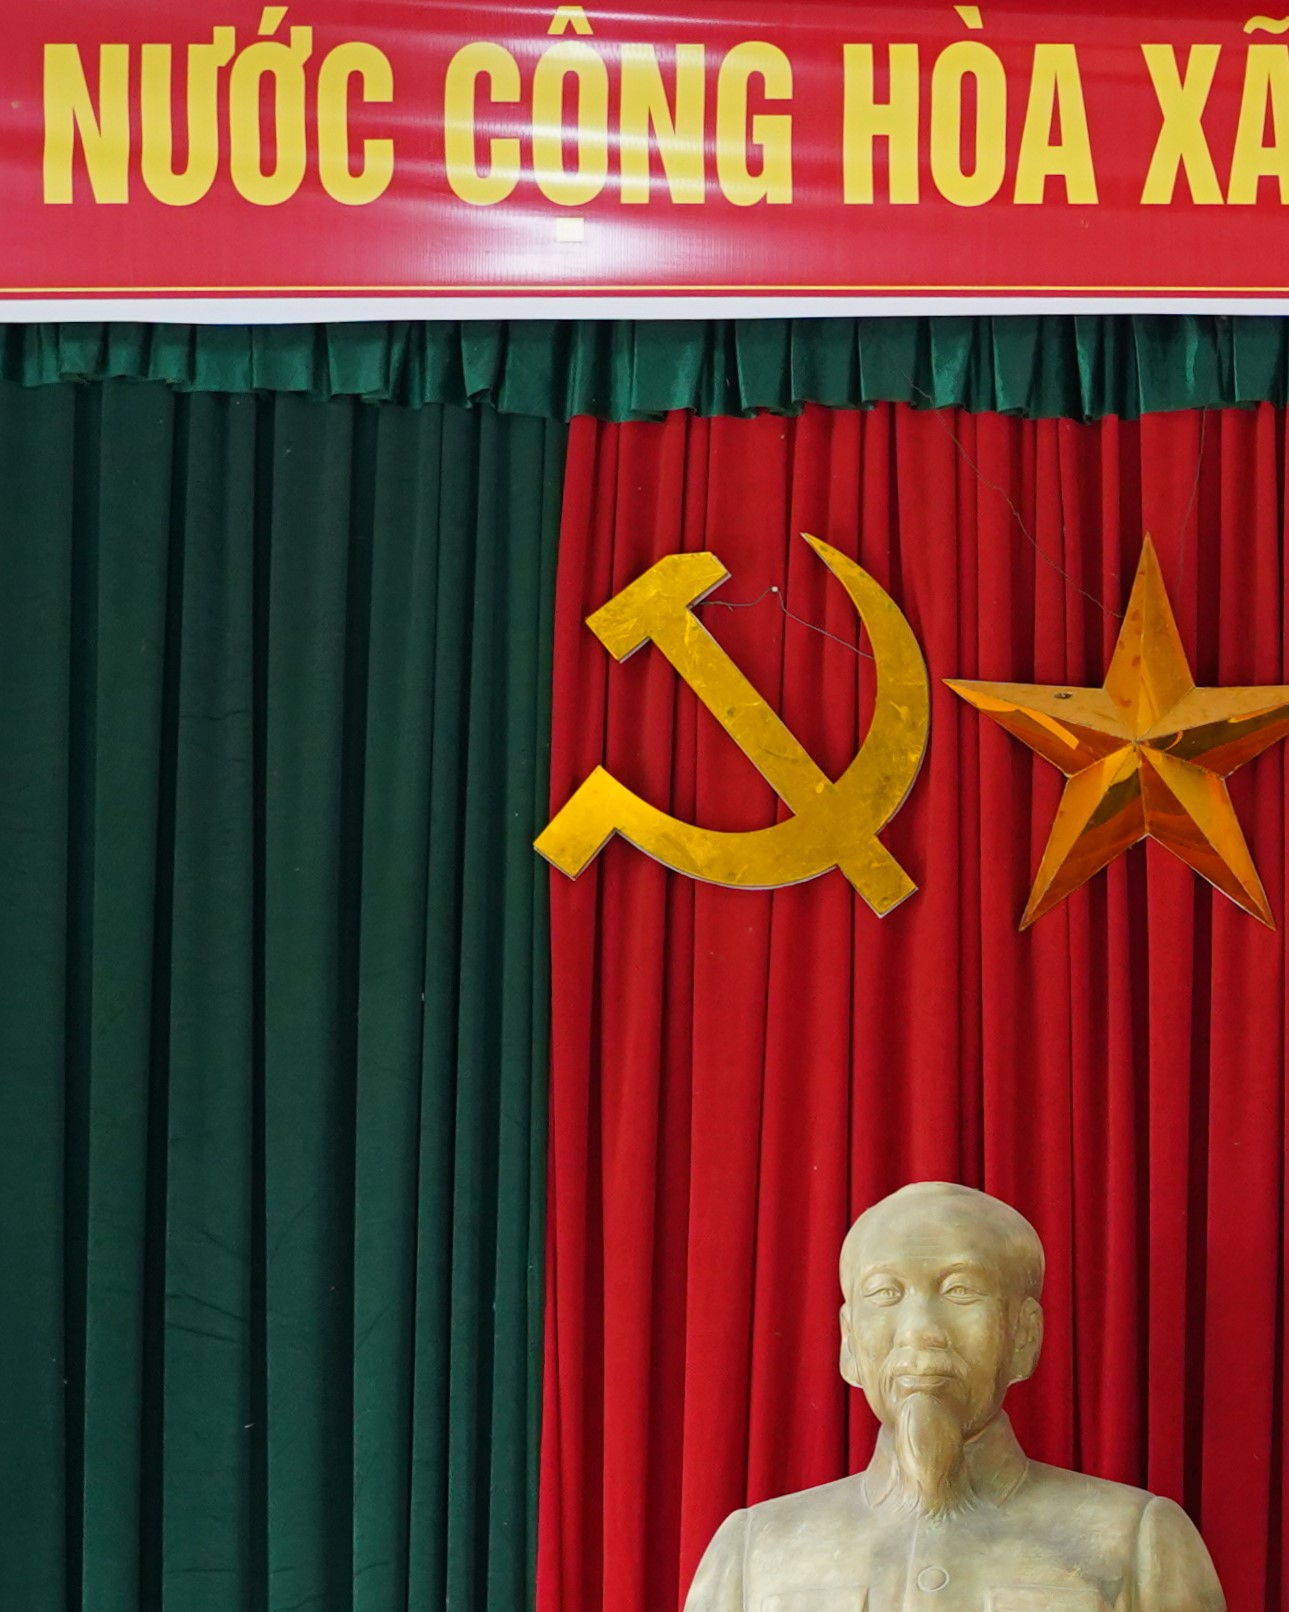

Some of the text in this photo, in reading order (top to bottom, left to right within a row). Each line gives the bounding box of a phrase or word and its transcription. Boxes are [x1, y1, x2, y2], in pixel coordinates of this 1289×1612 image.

[43, 6, 395, 206] NƯỚC
[444, 5, 793, 243] CỘNG
[842, 6, 1099, 208] HÒA
